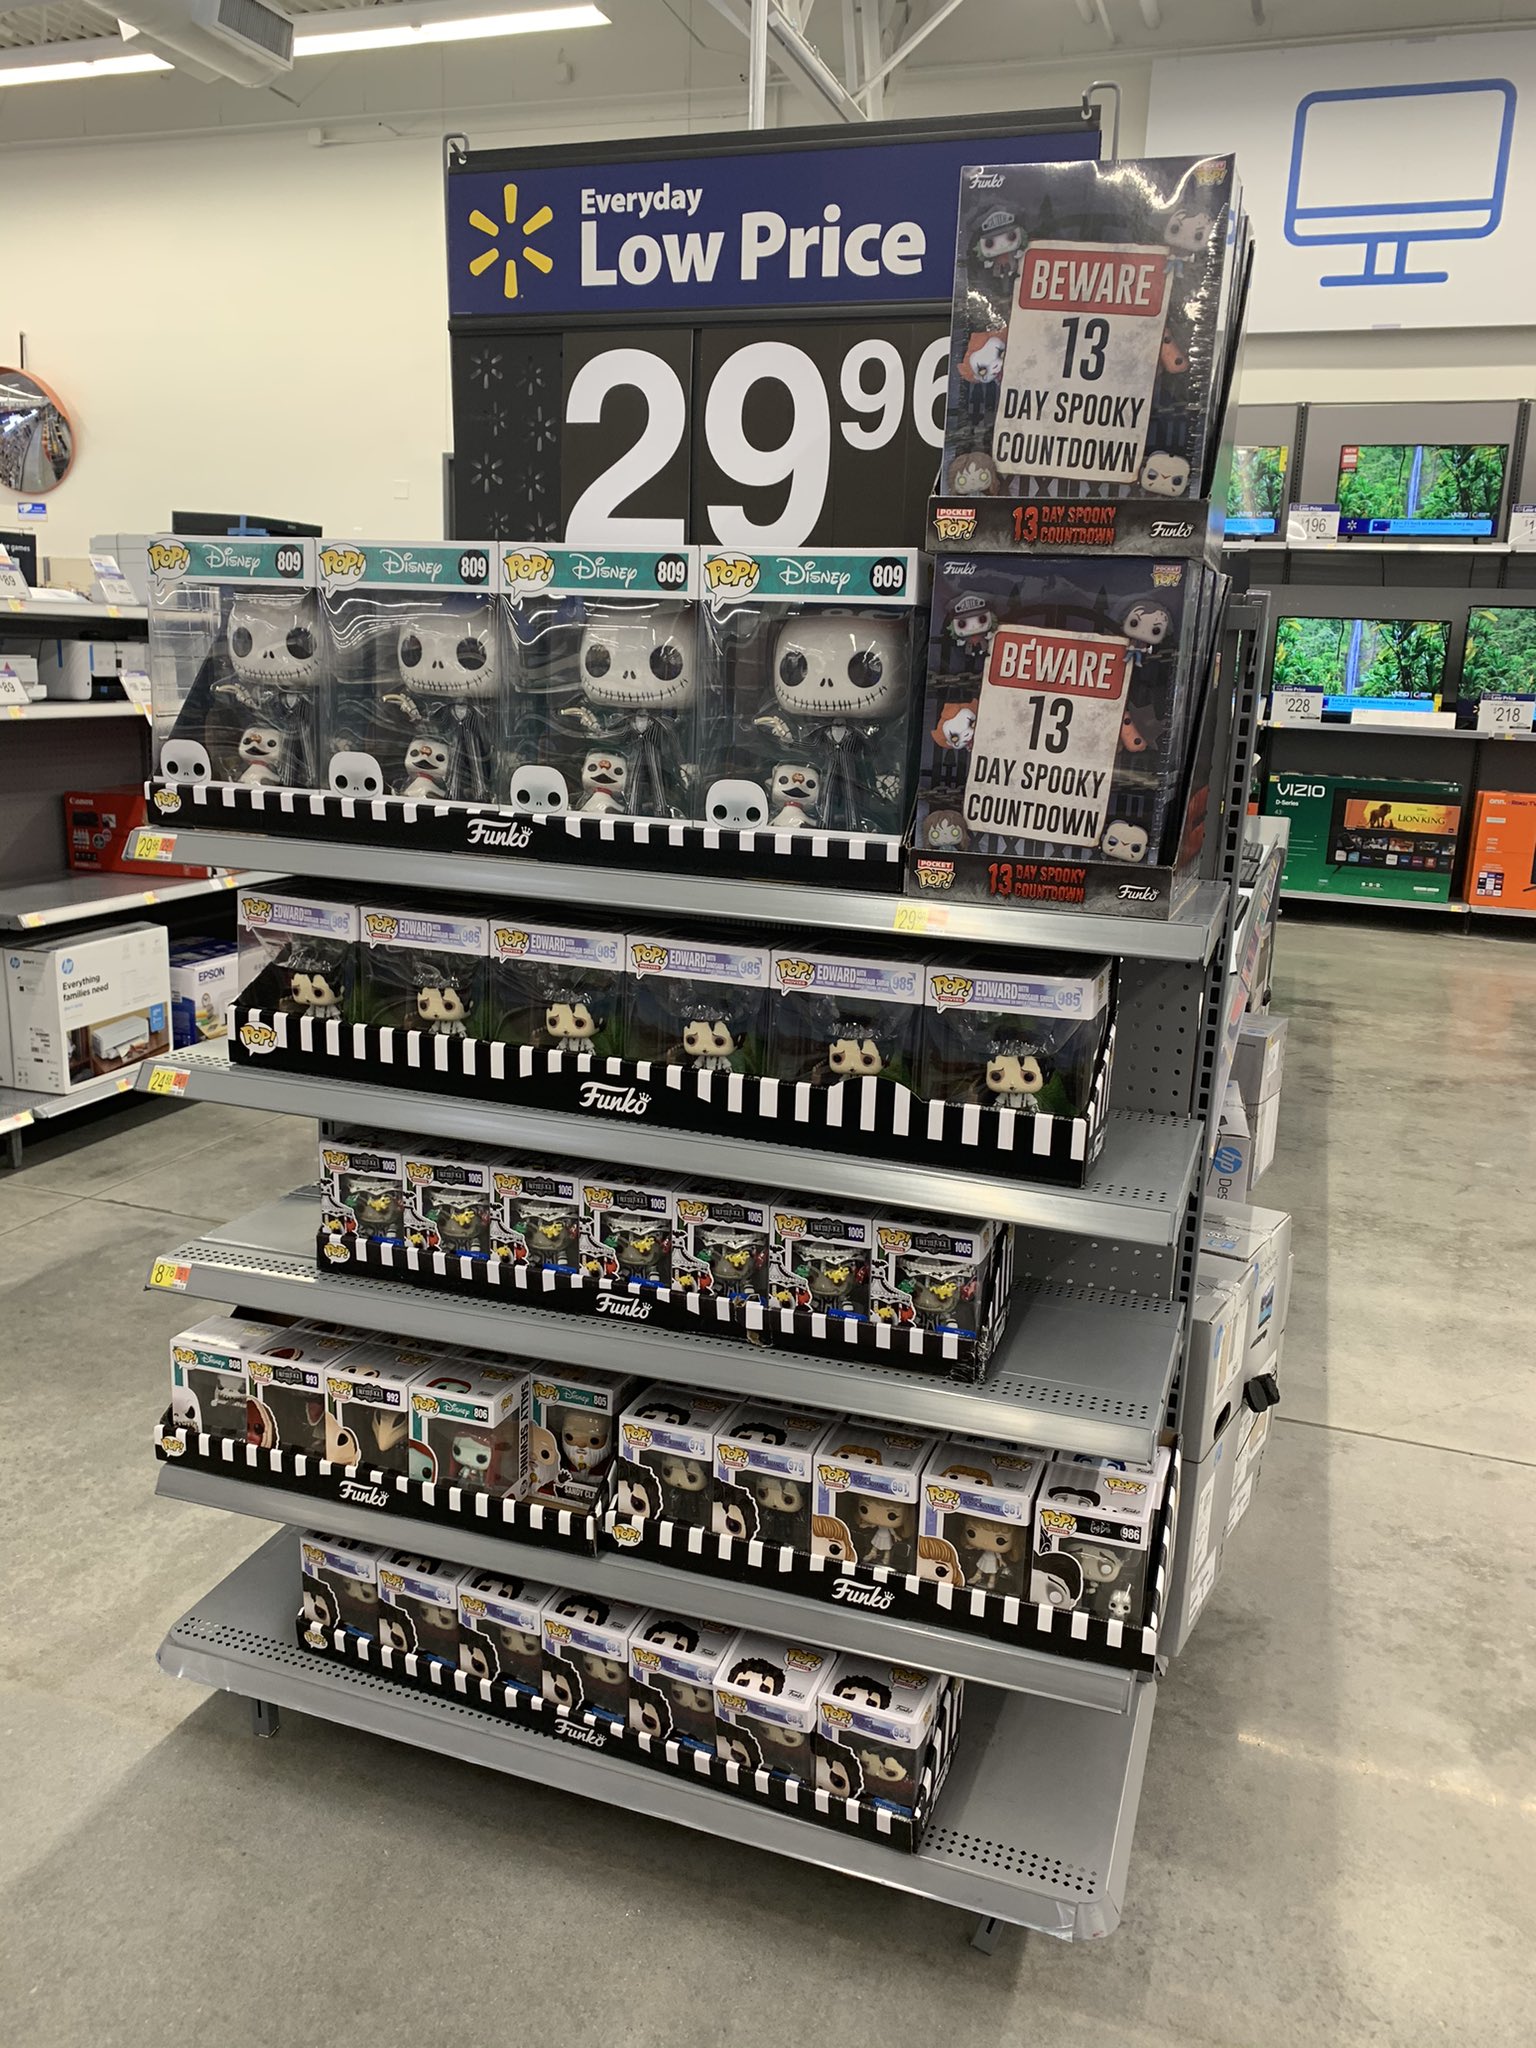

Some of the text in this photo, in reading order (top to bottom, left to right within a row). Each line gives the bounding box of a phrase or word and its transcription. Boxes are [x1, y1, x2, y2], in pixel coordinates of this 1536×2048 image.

[969, 173, 1006, 189] Funko
[581, 183, 703, 218] Everyday
[581, 204, 926, 286] Low Price
[1030, 259, 1155, 306] BEWARE
[1061, 316, 1110, 382] 13
[1004, 388, 1145, 429] DAY SPOOKY
[996, 432, 1138, 474] COUNTDOWN
[939, 508, 974, 517] POCKET
[934, 518, 977, 541] POP!
[1012, 506, 1117, 543] 13 DAY SPOOKY
[1150, 521, 1195, 538] Funko
[1040, 527, 1116, 545] COUNTDOWN
[148, 544, 301, 575] POP! Disney 809
[319, 548, 487, 582] POP! Disney 809
[503, 552, 686, 587] POP! Disney 809
[943, 561, 977, 575] Funko
[704, 558, 904, 594] POP! Disney 809
[1000, 641, 1116, 689] BEWARE
[1288, 698, 1310, 713] 228
[1496, 706, 1520, 722] 218
[1028, 695, 1074, 754] 13
[974, 755, 1106, 799] DAY SPOOKY
[1277, 783, 1326, 798] VIZIO
[69, 797, 94, 805] Canon
[967, 794, 1099, 838] COUNTDOWN
[1421, 817, 1446, 825] KING
[467, 818, 532, 847] Funko
[138, 837, 153, 857] 29
[920, 859, 952, 869] POCKET
[917, 868, 955, 889] POP!
[989, 863, 1086, 896] 13 DAY SPOOKY
[1015, 882, 1085, 903] COUNTDOWN
[1117, 884, 1160, 901] Funko
[241, 897, 271, 917] POP!
[274, 904, 305, 921] EDWARD
[365, 914, 398, 933] POP!
[400, 920, 432, 936] EDWARD
[462, 930, 480, 943] 985
[494, 928, 529, 948] POP!
[531, 935, 565, 951] EDWARD
[597, 945, 616, 958] 985
[631, 944, 667, 964] POP!
[670, 950, 706, 968] EDWARD
[199, 966, 225, 982] EPSON
[740, 961, 760, 975] 985
[775, 959, 815, 980] POP!
[817, 965, 856, 983] EDWARD
[63, 975, 100, 990] Everything
[64, 983, 109, 1001] families need
[892, 976, 913, 991] 985
[930, 975, 973, 997] POP!
[975, 981, 1018, 999] EDWARD
[1057, 992, 1080, 1006] 985
[240, 1026, 275, 1047] POP!
[579, 1081, 652, 1116] Funko
[323, 1150, 349, 1166] POP!
[382, 1160, 396, 1172] 1005
[1213, 1147, 1242, 1174] hp
[406, 1162, 433, 1179] POP!
[468, 1172, 482, 1184] 1005
[493, 1173, 522, 1191] POP!
[558, 1184, 572, 1196] 1005
[583, 1187, 612, 1204] POP!
[650, 1198, 665, 1210] 1005
[677, 1199, 708, 1217] POP!
[747, 1211, 762, 1223] 1005
[775, 1214, 807, 1232] POP!
[848, 1227, 864, 1238] 1005
[877, 1227, 911, 1247] POP!
[955, 1241, 972, 1254] 1005
[155, 1265, 165, 1283] 8
[596, 1292, 653, 1319] Funko
[305, 1374, 318, 1385] 993
[327, 1378, 352, 1395] POP!
[386, 1392, 399, 1403] 992
[532, 1382, 560, 1400] POP!
[411, 1395, 439, 1414] POP!
[474, 1408, 488, 1419] 806
[520, 1380, 529, 1422] SALLY
[623, 1423, 651, 1442] POP!
[520, 1423, 529, 1478] SEWING
[718, 1444, 748, 1464] POP!
[817, 1464, 849, 1483] POP!
[339, 1480, 390, 1507] Funko
[926, 1484, 959, 1503] POP!
[613, 1524, 641, 1543] POP!
[1040, 1508, 1077, 1530] POP!
[1122, 1528, 1140, 1540] 986
[832, 1577, 895, 1610] Funko
[544, 1620, 571, 1638] POP!
[632, 1647, 661, 1666] POP!
[821, 1703, 853, 1722] POP!
[554, 1719, 607, 1747] Funko
